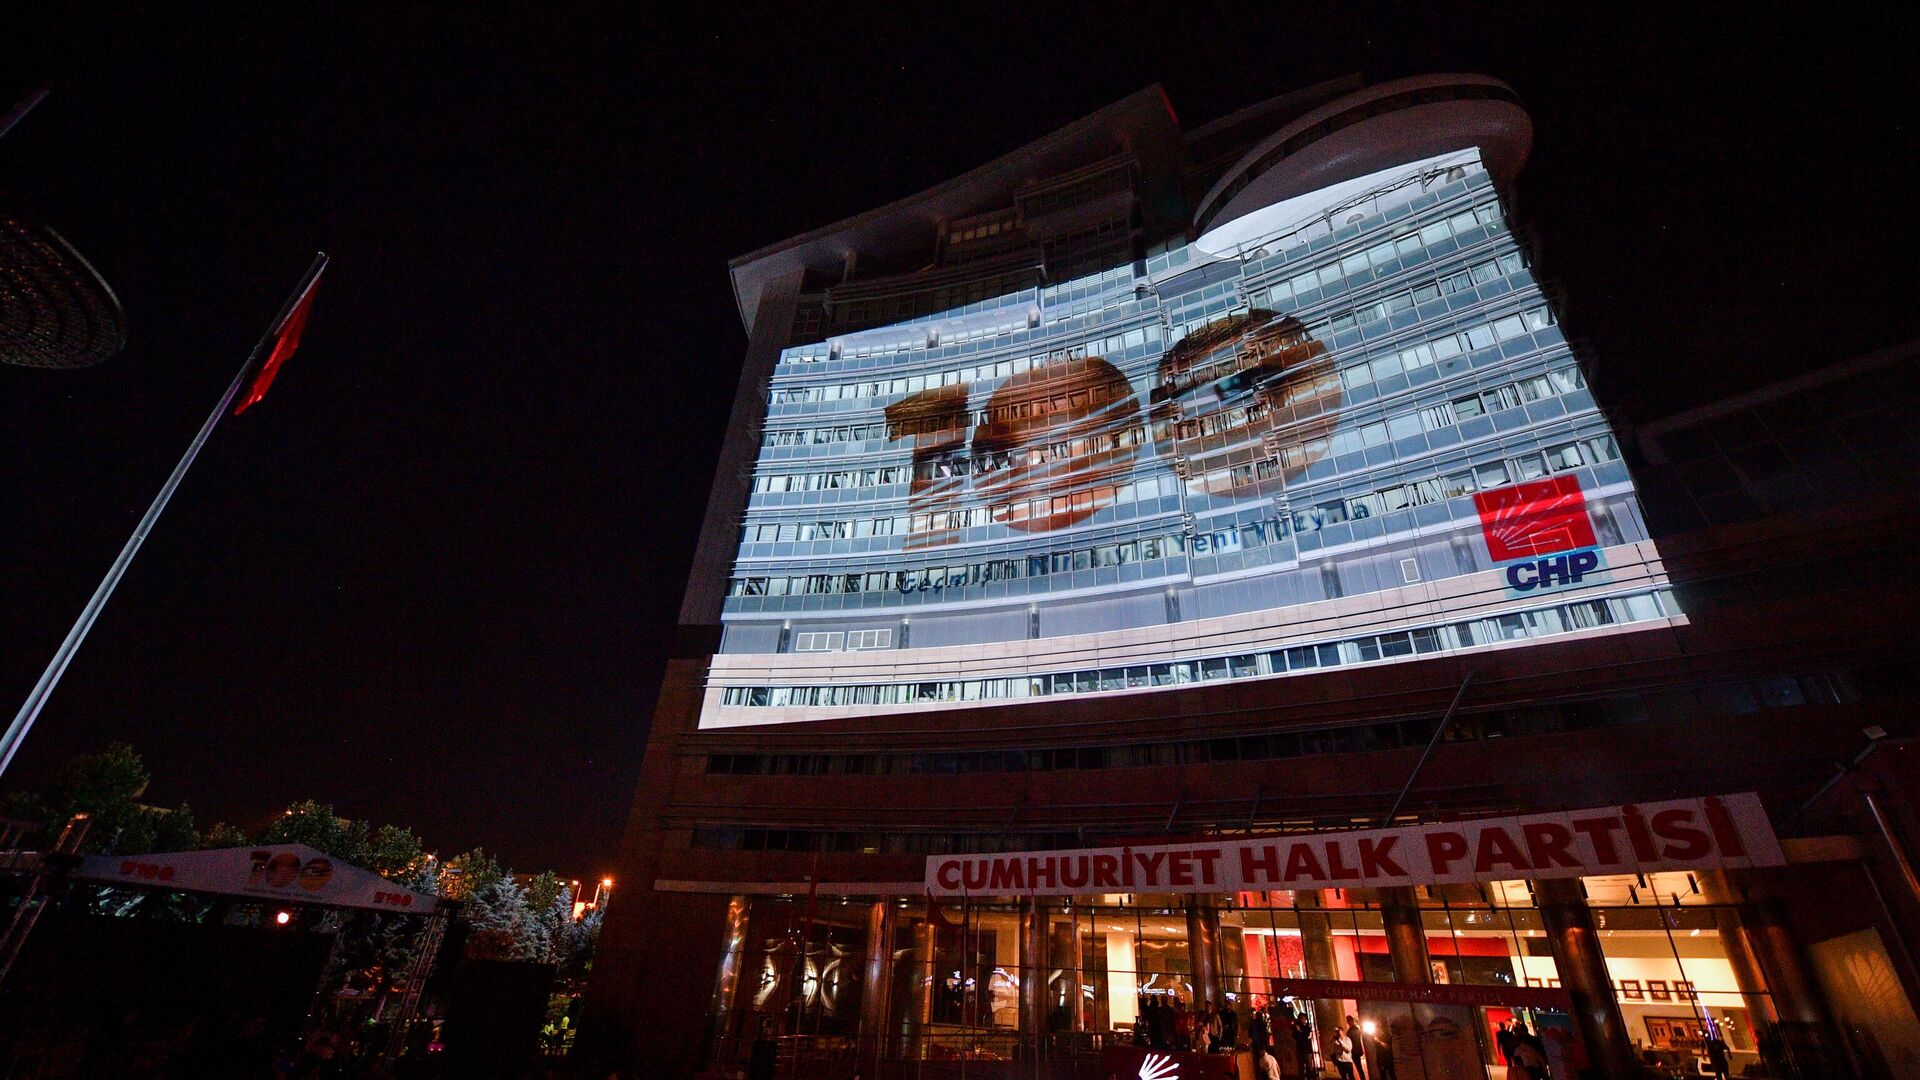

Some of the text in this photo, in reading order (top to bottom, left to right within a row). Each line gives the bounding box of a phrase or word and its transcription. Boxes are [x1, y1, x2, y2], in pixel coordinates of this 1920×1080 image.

[1173, 523, 1238, 554] Yeni
[1506, 551, 1598, 591] CHP
[937, 795, 1746, 890] CUMHURİYET HALK PARTİSİ
